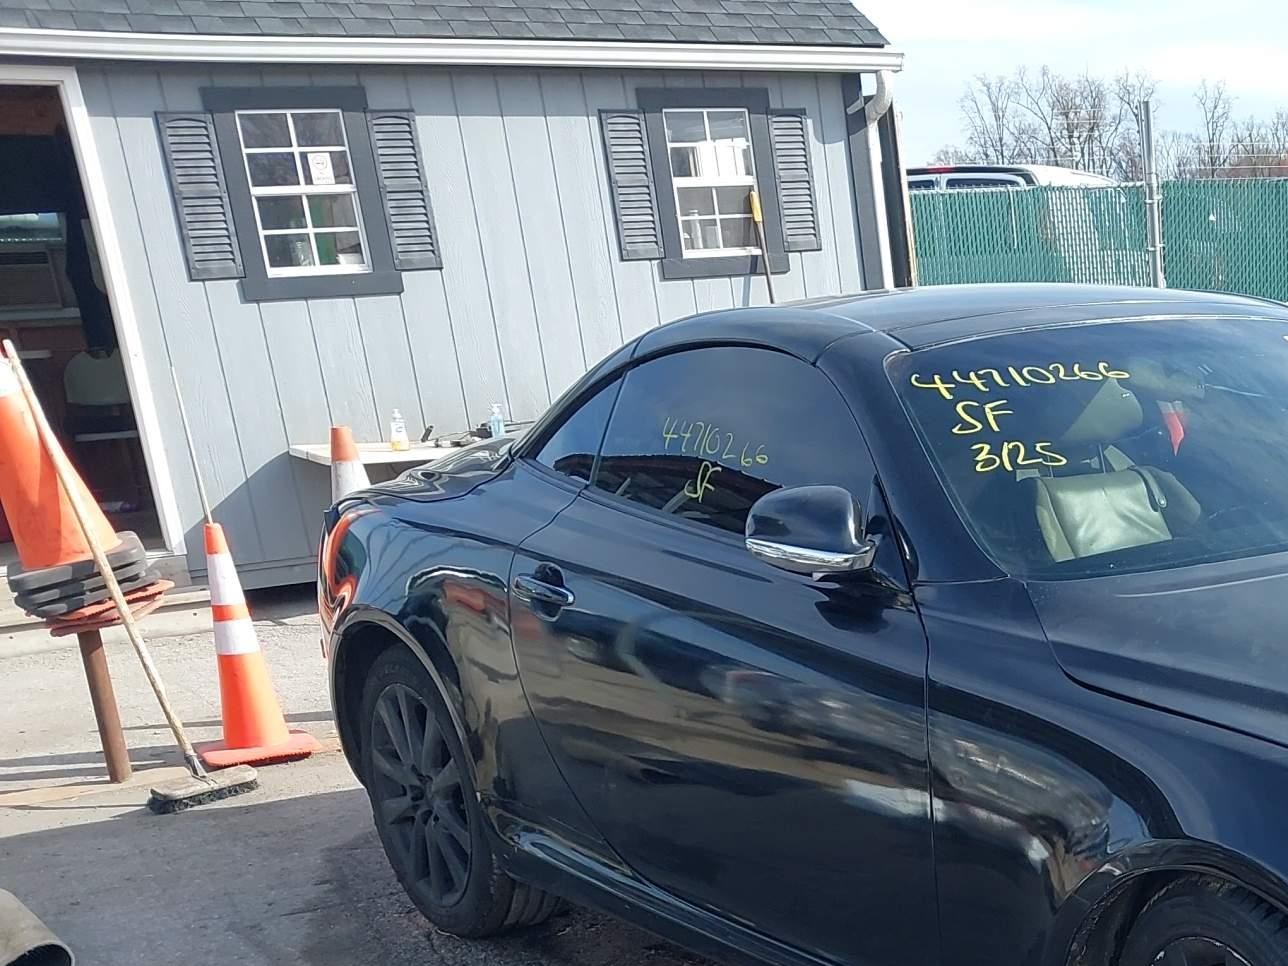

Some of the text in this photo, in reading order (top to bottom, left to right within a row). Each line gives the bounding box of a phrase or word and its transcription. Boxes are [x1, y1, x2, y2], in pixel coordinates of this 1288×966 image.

[910, 361, 1131, 400] 44710266
[951, 399, 1015, 435] SF
[661, 416, 769, 467] 44710266
